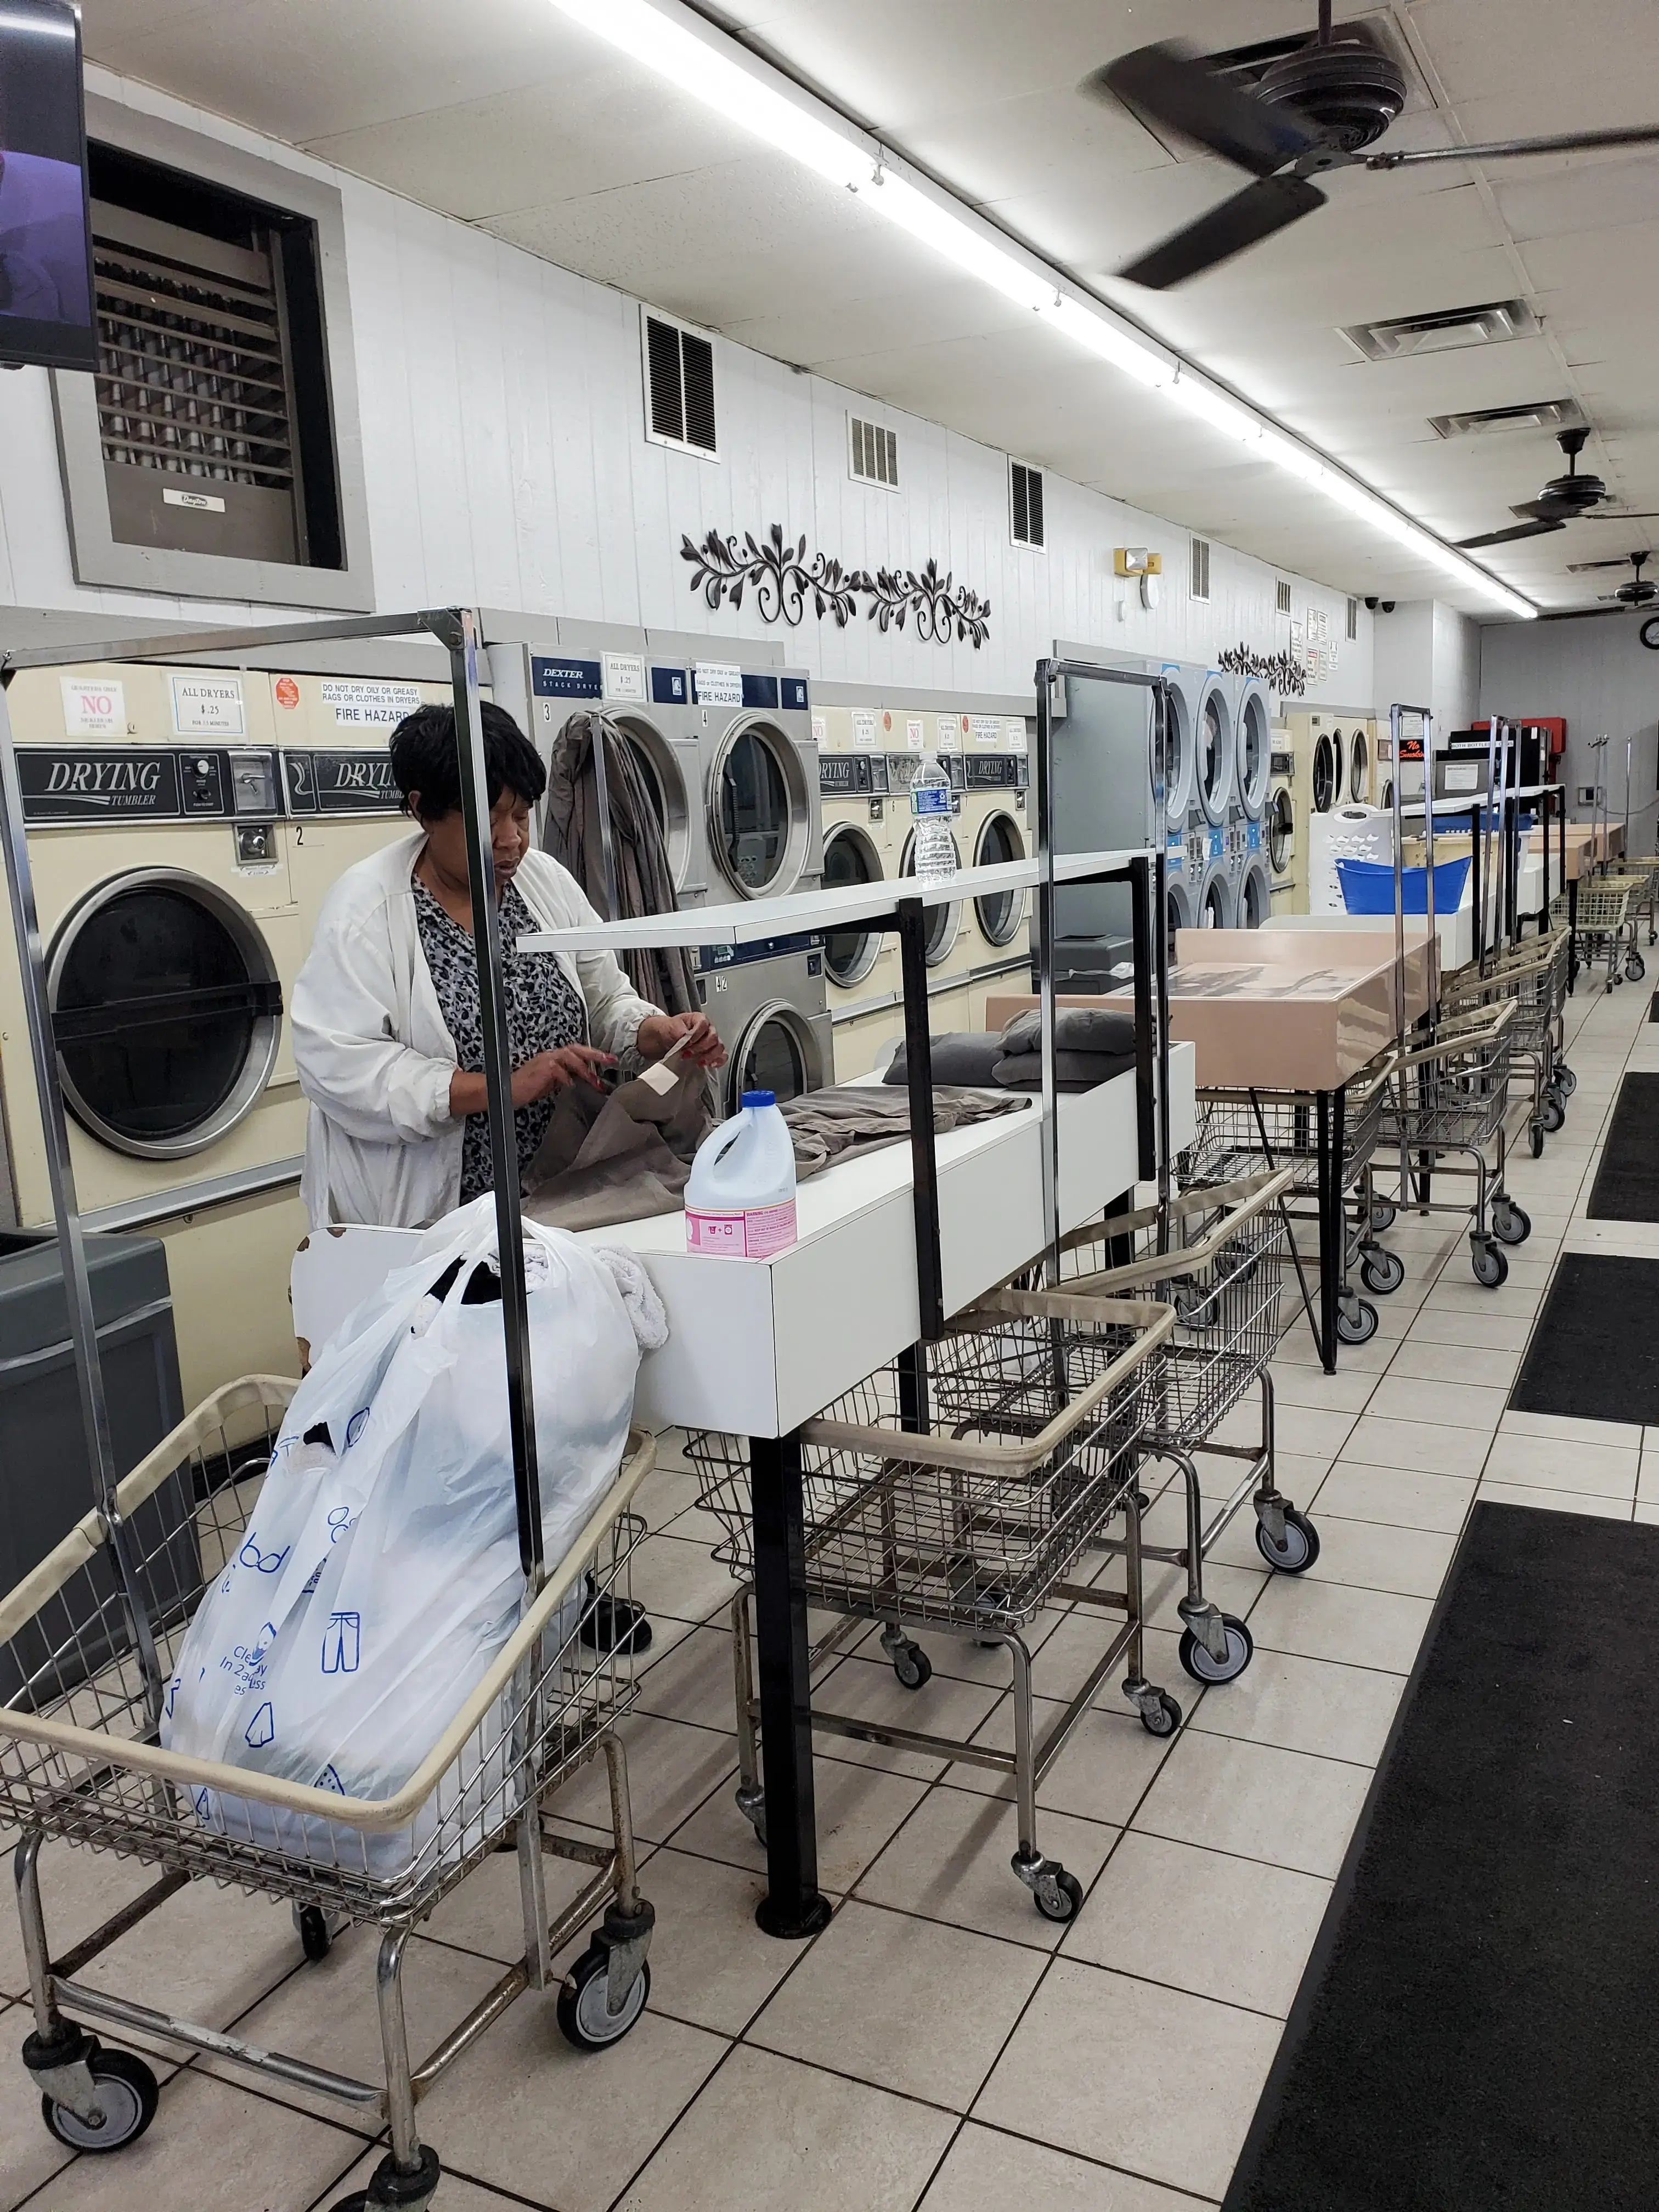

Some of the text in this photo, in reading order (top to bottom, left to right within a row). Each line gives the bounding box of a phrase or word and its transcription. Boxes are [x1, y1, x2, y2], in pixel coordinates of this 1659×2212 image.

[183, 495, 207, 505] Dayton
[543, 668, 584, 679] DEXTER
[366, 686, 380, 694] OILY
[393, 687, 417, 696] GREASY
[543, 680, 601, 691] STACK DRYE
[182, 687, 235, 699] ALL DRYERS
[356, 695, 385, 703] CLOTHES
[698, 691, 741, 703] FIRE HAZARD
[81, 695, 112, 714] NO
[201, 703, 219, 715] $ .25
[335, 708, 360, 720] FIRE
[545, 704, 550, 721] 3
[703, 711, 707, 726] 4
[910, 728, 919, 738] NO
[1407, 741, 1420, 750] No
[44, 761, 161, 792] DRYING
[111, 794, 156, 806] TUMBLER
[892, 800, 895, 812] 6
[296, 826, 303, 845] 2
[716, 976, 727, 991] 42
[220, 1656, 233, 1671] In
